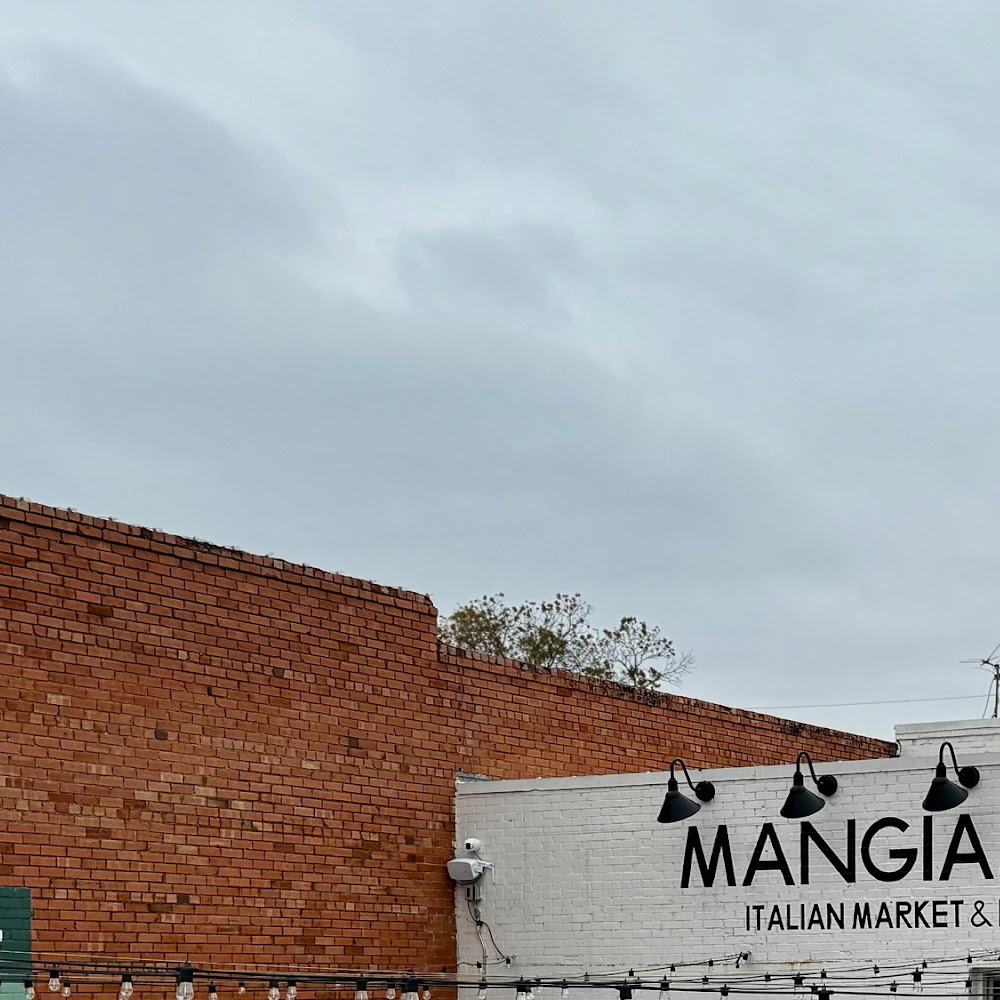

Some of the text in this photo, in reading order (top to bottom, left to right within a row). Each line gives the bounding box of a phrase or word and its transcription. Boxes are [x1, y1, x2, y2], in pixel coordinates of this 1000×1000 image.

[746, 902, 845, 931] ITALIAN
[851, 899, 965, 930] MARKET
[970, 900, 993, 928] &
